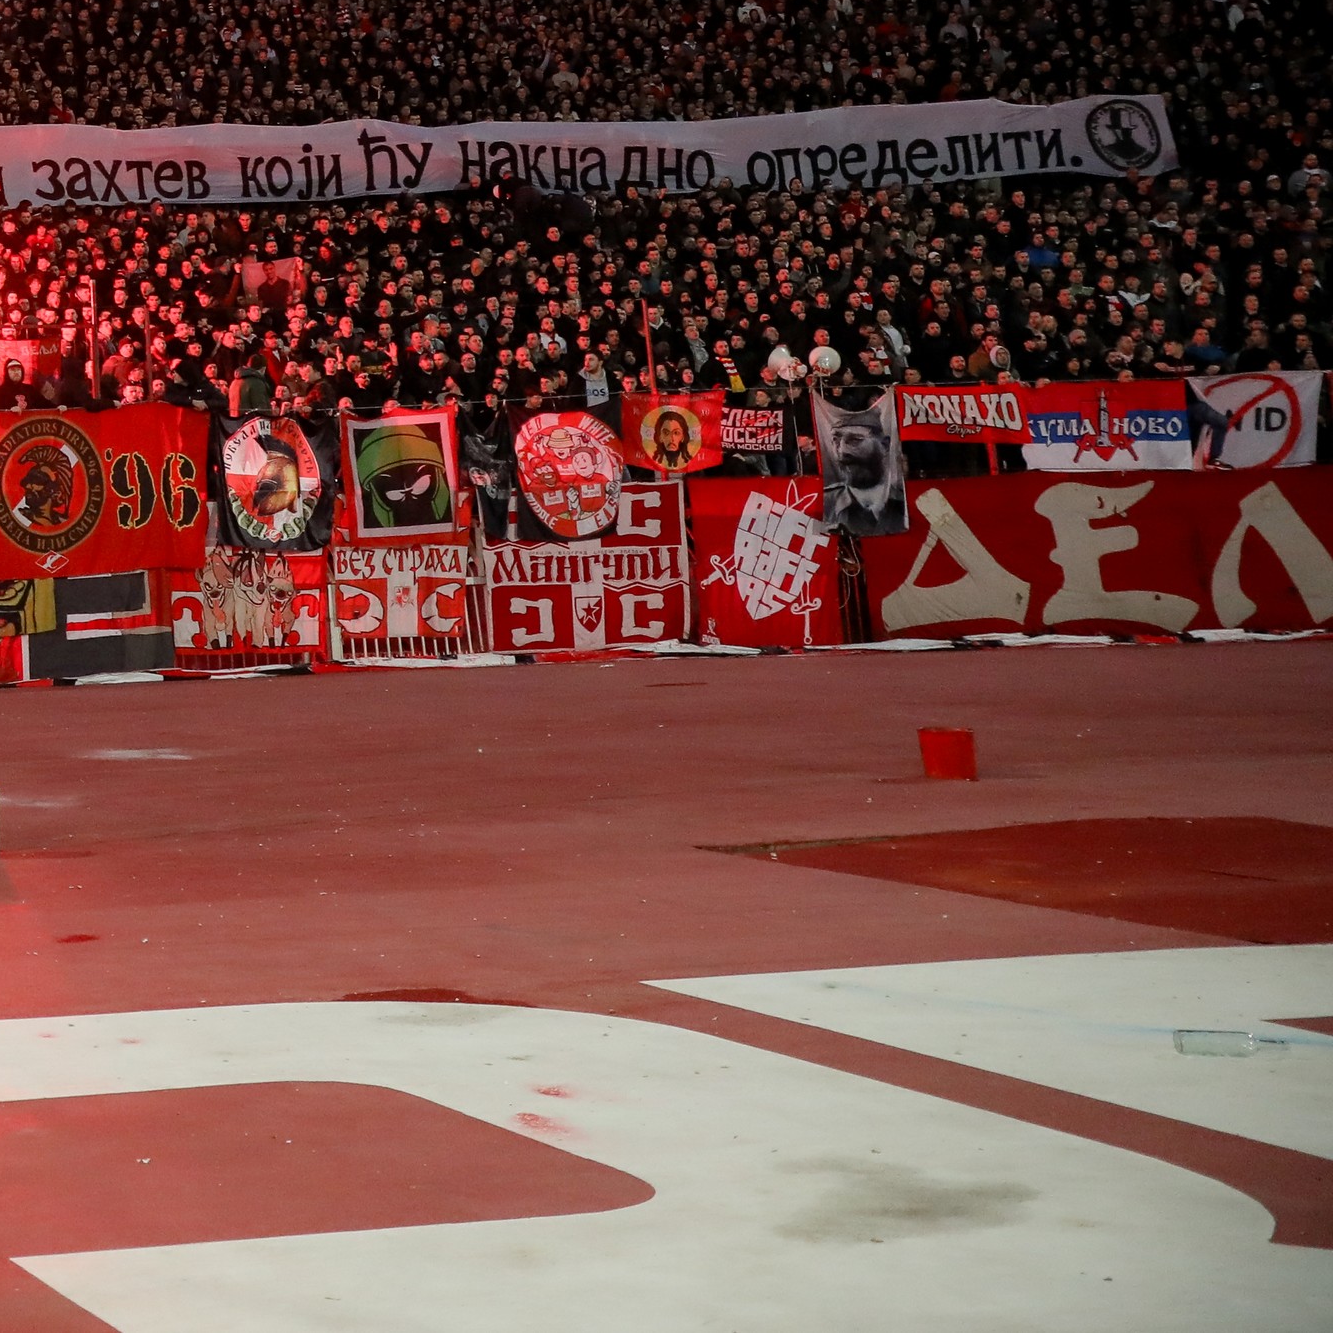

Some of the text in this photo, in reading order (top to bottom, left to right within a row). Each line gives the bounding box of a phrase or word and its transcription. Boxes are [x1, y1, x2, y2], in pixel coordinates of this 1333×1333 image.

[33, 155, 211, 202] захтев
[239, 142, 343, 201] који
[356, 127, 434, 192] ћу
[458, 138, 715, 194] накнадно
[60, 424, 89, 457] FIRM
[737, 443, 783, 451] МОСКВА
[36, 537, 67, 550] ИЛИ
[68, 484, 102, 542] СМЕРТЬ
[336, 543, 463, 585] БЕЗ СТРАХА
[492, 547, 684, 584] Мангупи
